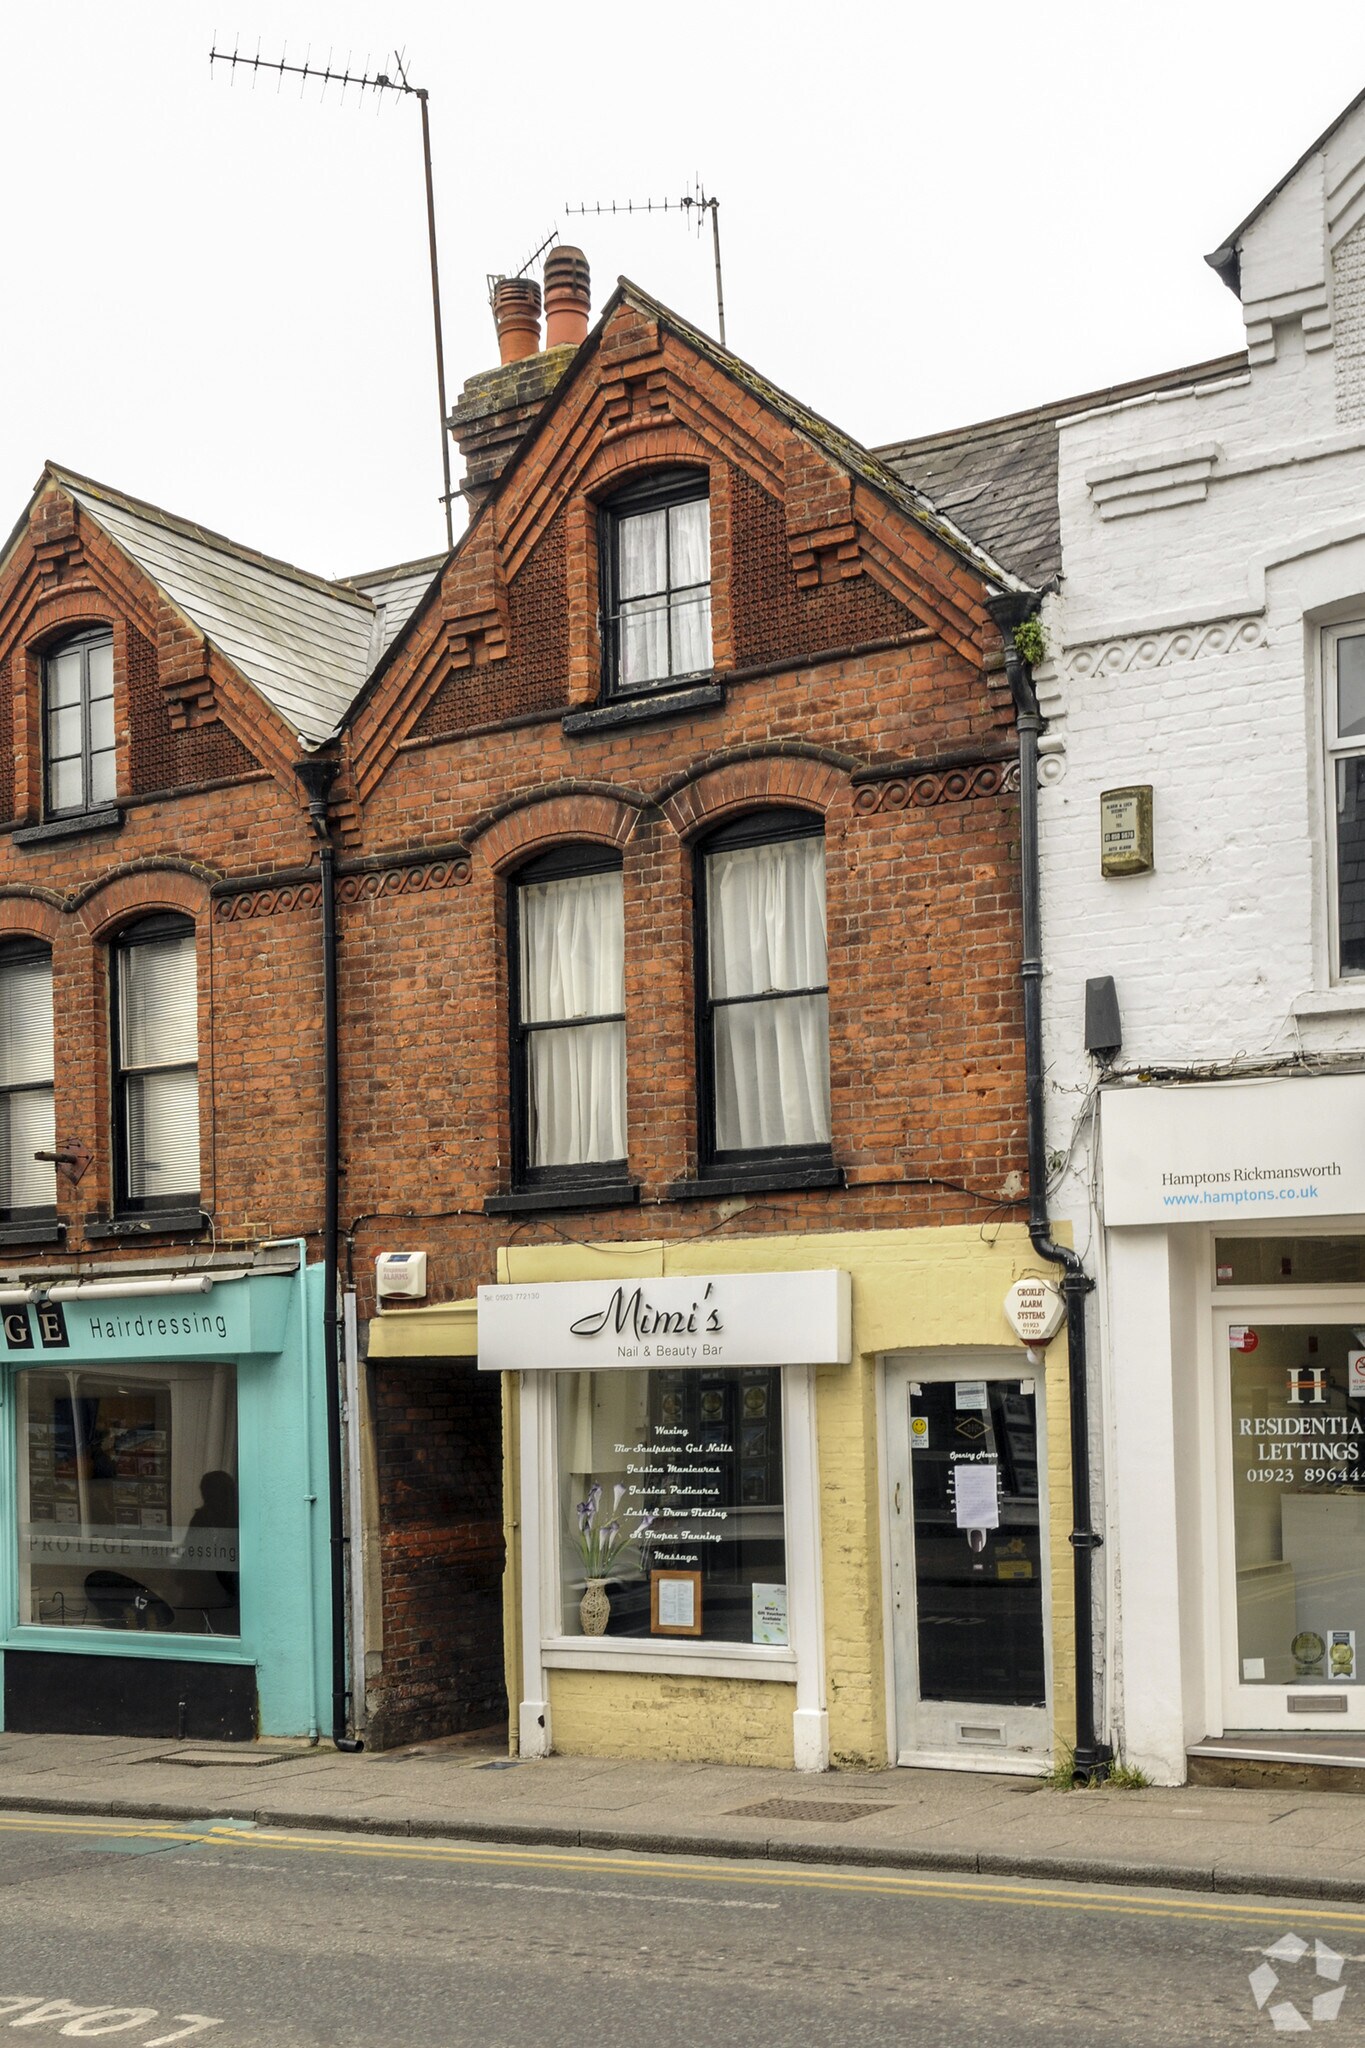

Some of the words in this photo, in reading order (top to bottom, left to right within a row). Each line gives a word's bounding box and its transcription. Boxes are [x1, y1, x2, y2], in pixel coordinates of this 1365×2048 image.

[1162, 1172, 1231, 1187] Hamptons
[1233, 1162, 1341, 1182] Rickmansworth
[1163, 1185, 1319, 1206] www.hamptons.co.uk
[1017, 1288, 1046, 1297] CROXLEY
[1020, 1300, 1043, 1308] ALARM
[569, 1282, 724, 1342] Mimi's
[1017, 1312, 1046, 1320] SYSTEMS
[89, 1311, 227, 1339] Hairdressing
[617, 1346, 639, 1358] Nail
[643, 1346, 651, 1357] &
[656, 1345, 697, 1358] Beauty
[702, 1344, 723, 1356] Bar
[654, 1426, 689, 1437] Waxing
[1239, 1416, 1365, 1436] RESIDENTIA
[633, 1443, 682, 1454] Sculpture
[685, 1443, 703, 1453] Gel
[706, 1443, 734, 1453] Nails
[1258, 1442, 1360, 1461] LETTINGS
[949, 1451, 976, 1461] Opening
[976, 1450, 999, 1460] Hours
[626, 1463, 664, 1474] Jessica
[667, 1464, 721, 1473] Manicures
[1246, 1468, 1295, 1483] 01923
[629, 1485, 667, 1496] Jessica
[670, 1485, 720, 1495] Pedicures
[623, 1507, 649, 1517] Lash
[652, 1507, 660, 1517] &
[662, 1507, 689, 1517] Brow
[691, 1507, 728, 1520] Tinting
[629, 1531, 642, 1539] St
[681, 1530, 722, 1543] Tanning
[141, 1543, 237, 1562] Hairdessing
[653, 1551, 698, 1563] Massage
